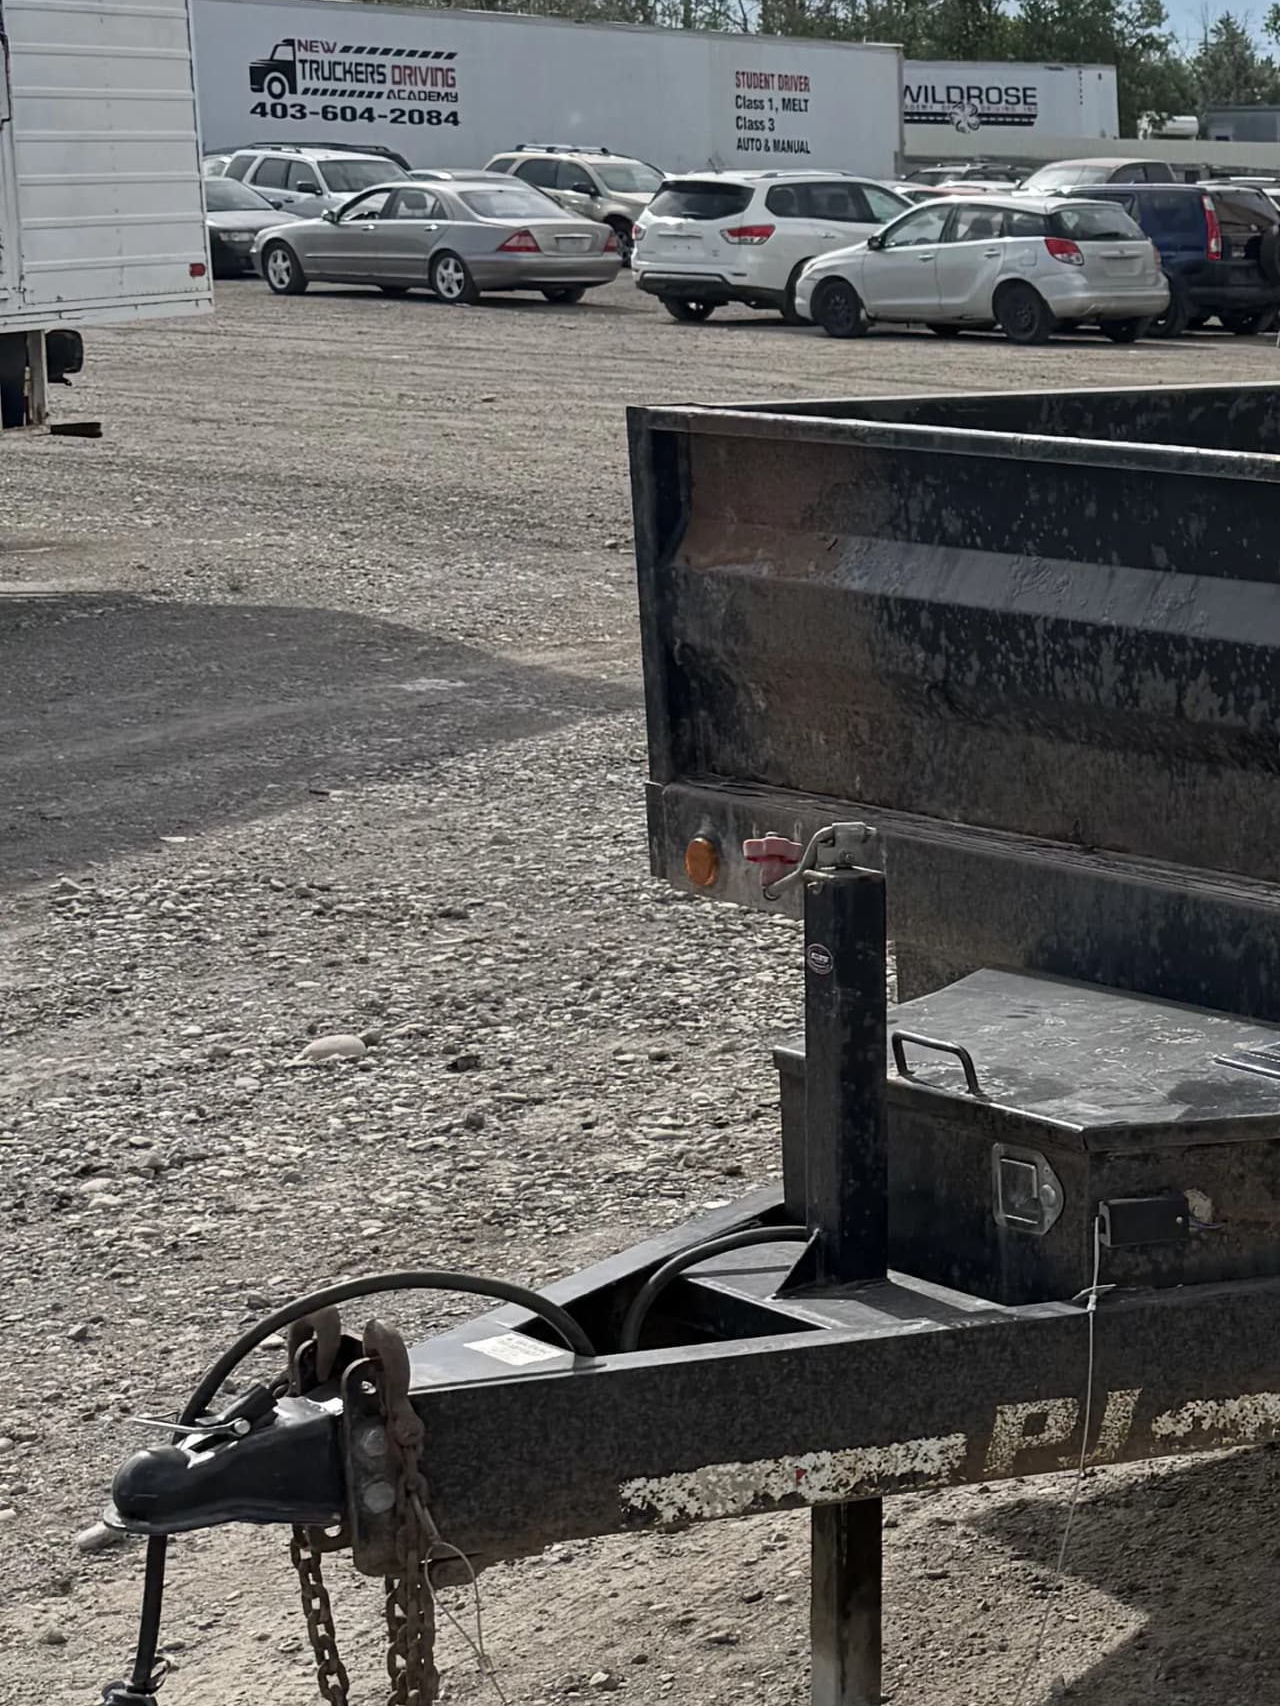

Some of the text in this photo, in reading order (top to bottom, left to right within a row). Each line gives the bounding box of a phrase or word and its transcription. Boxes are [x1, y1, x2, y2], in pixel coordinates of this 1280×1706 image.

[297, 39, 337, 54] NEW
[298, 59, 456, 88] TRUCKERS DRIVING
[735, 70, 811, 92] STUDENT DRIVER
[386, 89, 459, 103] ACADEMY
[735, 94, 765, 111] Class
[782, 97, 809, 113] MELT
[249, 101, 460, 126] 403-604-2084
[735, 115, 776, 132] Class 3
[736, 137, 811, 155] AUTO & MANUAL
